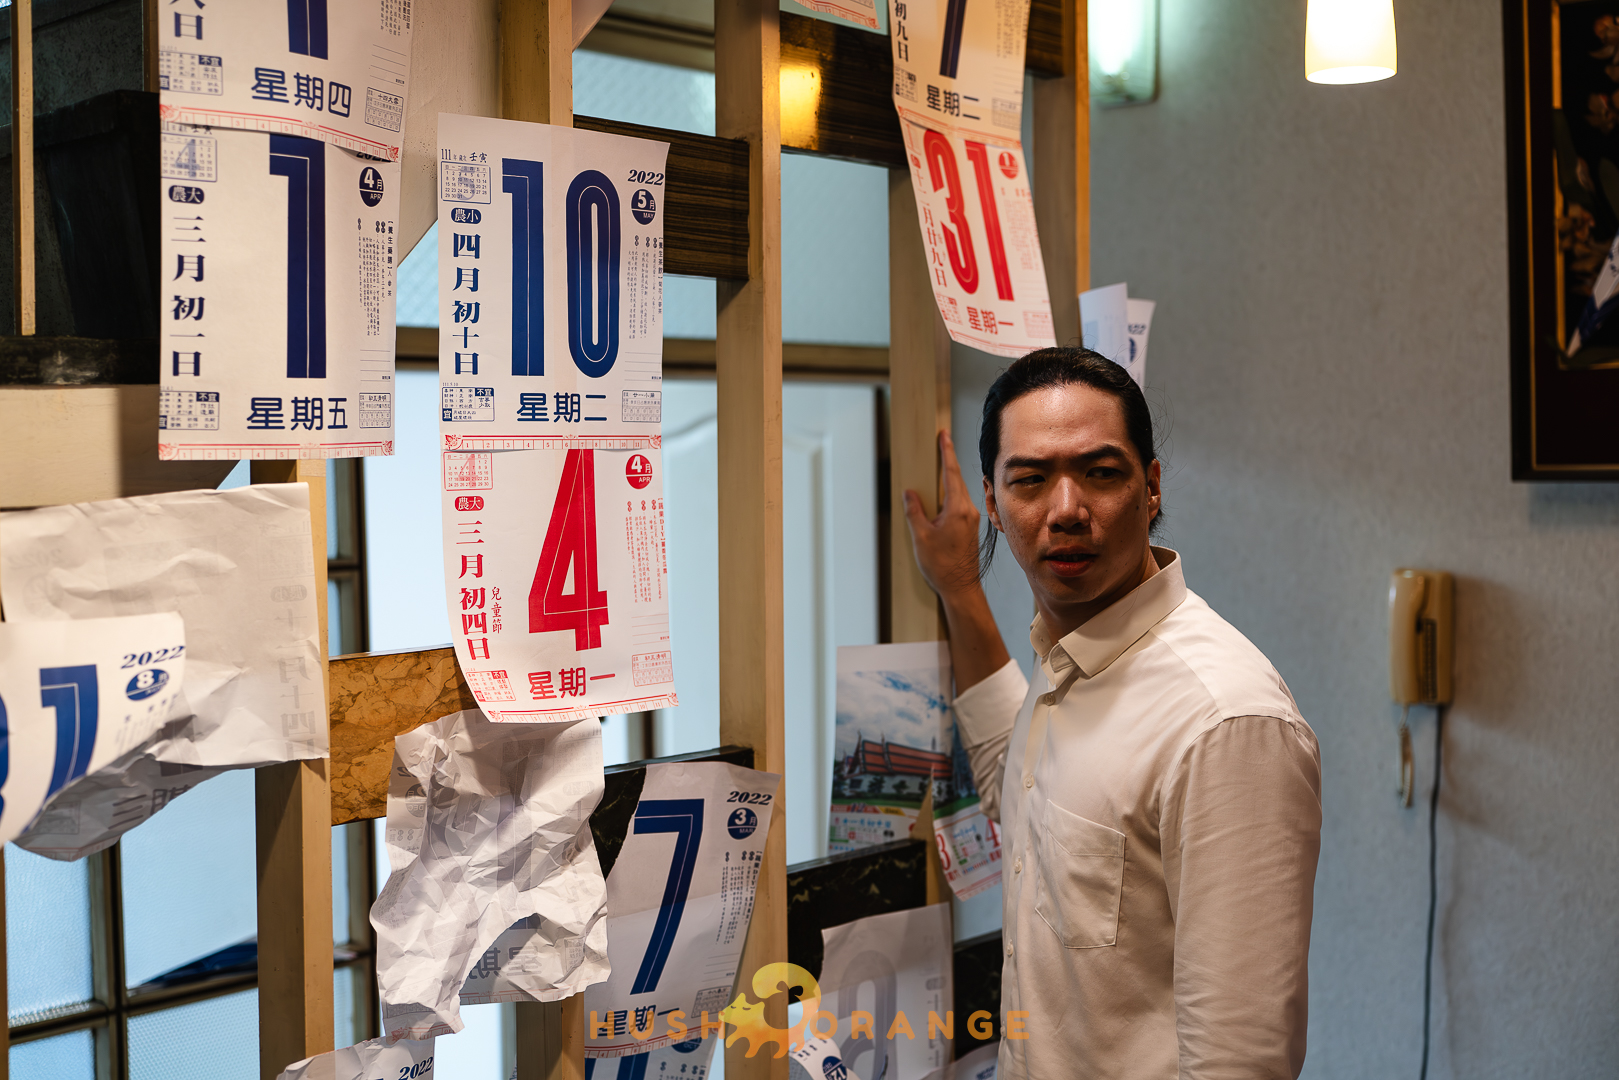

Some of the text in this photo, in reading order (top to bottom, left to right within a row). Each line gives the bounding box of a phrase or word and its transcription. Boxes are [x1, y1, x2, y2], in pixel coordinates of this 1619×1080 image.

[251, 67, 353, 118] 星期四
[926, 84, 981, 120] 星期二
[627, 169, 664, 186] 2022
[454, 209, 479, 223] 農小
[637, 190, 655, 210] 5月
[923, 128, 1015, 302] 31
[269, 132, 326, 378] 1
[502, 157, 621, 378] 10
[170, 216, 207, 377] 三月初一日
[452, 233, 481, 375] 四月初十日
[966, 306, 1014, 335] 星期一
[247, 396, 348, 431] 星期五
[516, 392, 608, 423] 星期二
[631, 455, 651, 474] 4月
[457, 497, 482, 510] 農大
[528, 449, 610, 652] 4
[456, 519, 491, 661] 三月初四日
[490, 586, 502, 634] 兒童節
[121, 646, 185, 669] 2022
[527, 666, 616, 700] 星期一
[727, 791, 773, 806] 2022
[734, 808, 757, 827] 3月
[630, 798, 705, 995] 7
[598, 1004, 680, 1037] 星期一
[400, 1057, 434, 1080] 2022
